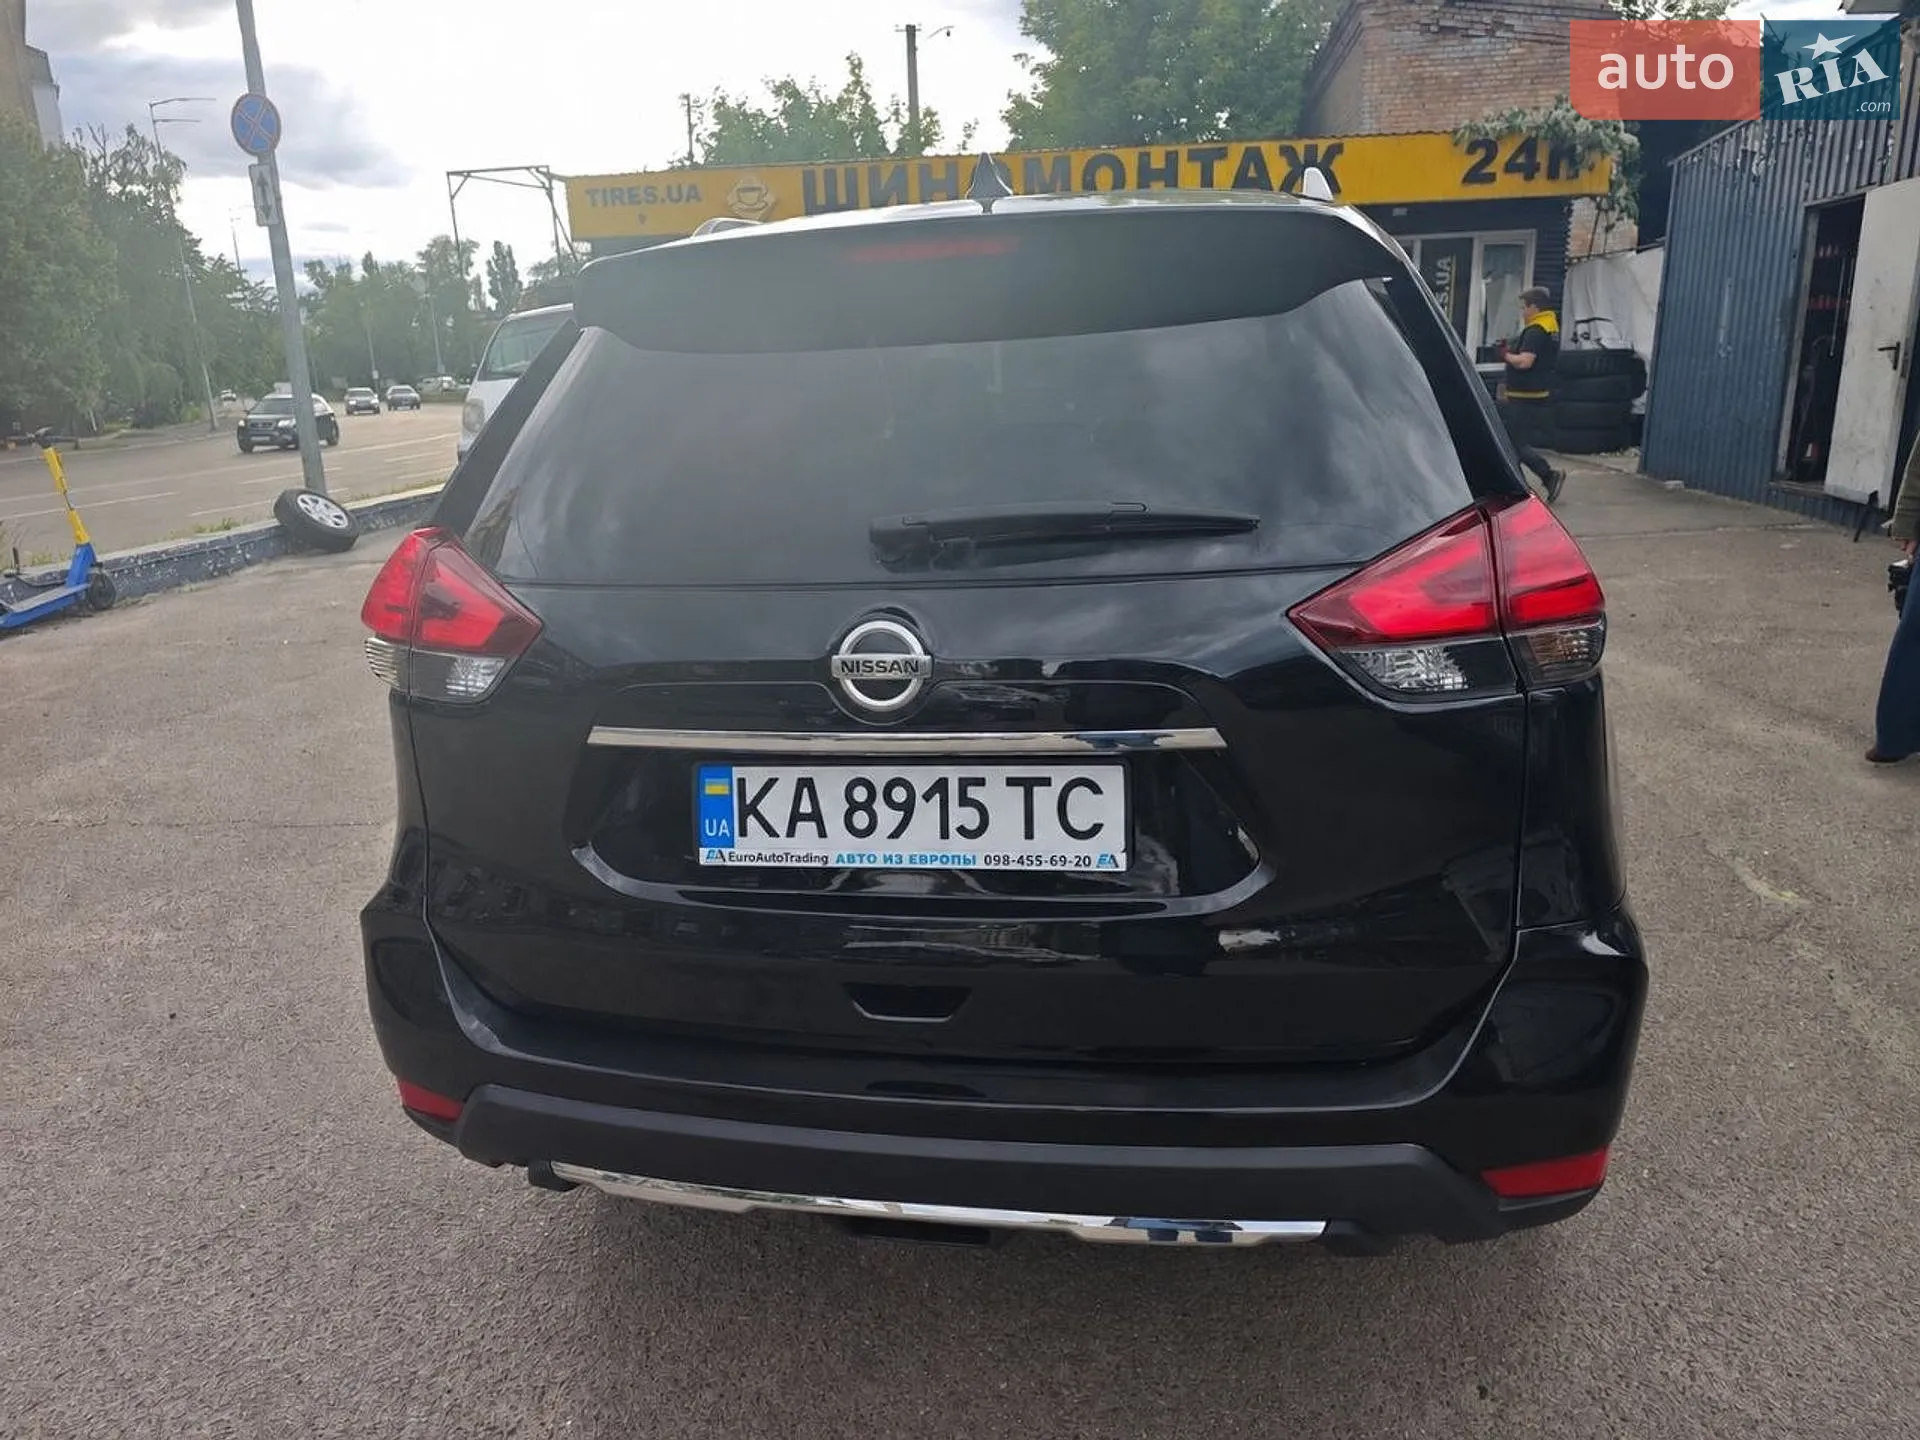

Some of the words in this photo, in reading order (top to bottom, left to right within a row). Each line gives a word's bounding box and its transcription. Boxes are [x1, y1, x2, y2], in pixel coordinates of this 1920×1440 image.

[586, 183, 702, 207] TIRES.UA
[841, 660, 919, 674] NISSAN
[737, 777, 828, 838] KA
[843, 776, 989, 840] 8915
[1005, 776, 1104, 840] TC
[705, 819, 730, 837] UA
[728, 852, 829, 865] EuroAutoTrading
[835, 853, 877, 865] АВТО
[883, 854, 904, 865] ИЗ
[909, 854, 976, 866] ЕВРОПЫ
[984, 854, 1091, 867] 098-455-69-20
